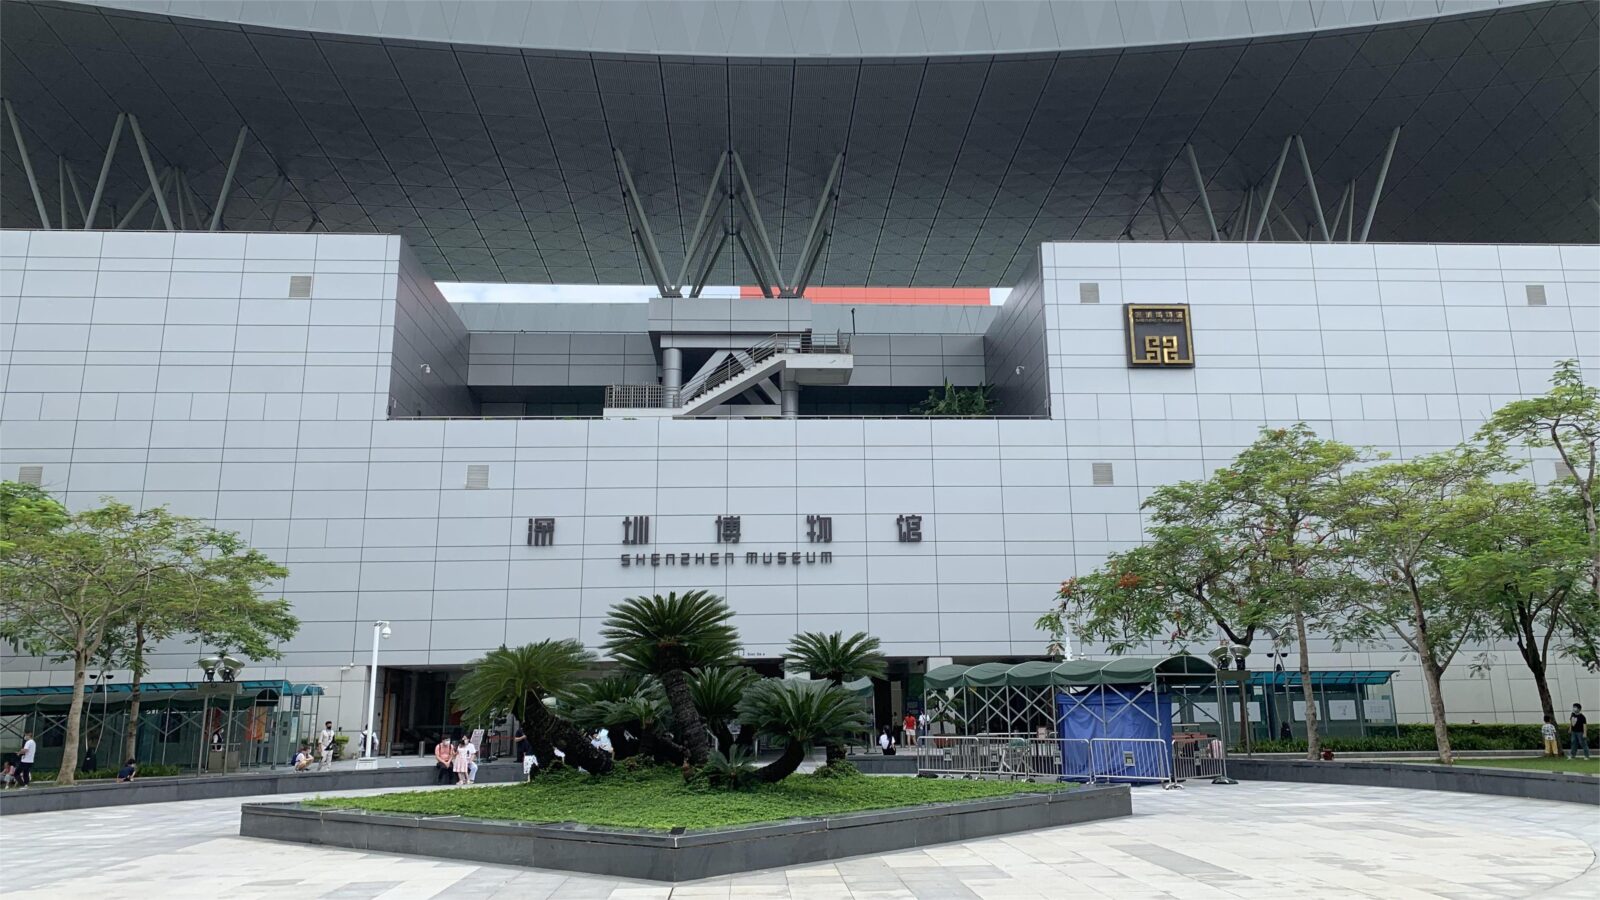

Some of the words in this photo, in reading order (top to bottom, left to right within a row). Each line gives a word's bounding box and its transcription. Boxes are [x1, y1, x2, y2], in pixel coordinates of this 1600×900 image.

[526, 514, 923, 548] 深圳博物馆
[745, 551, 833, 567] MUSEUM
